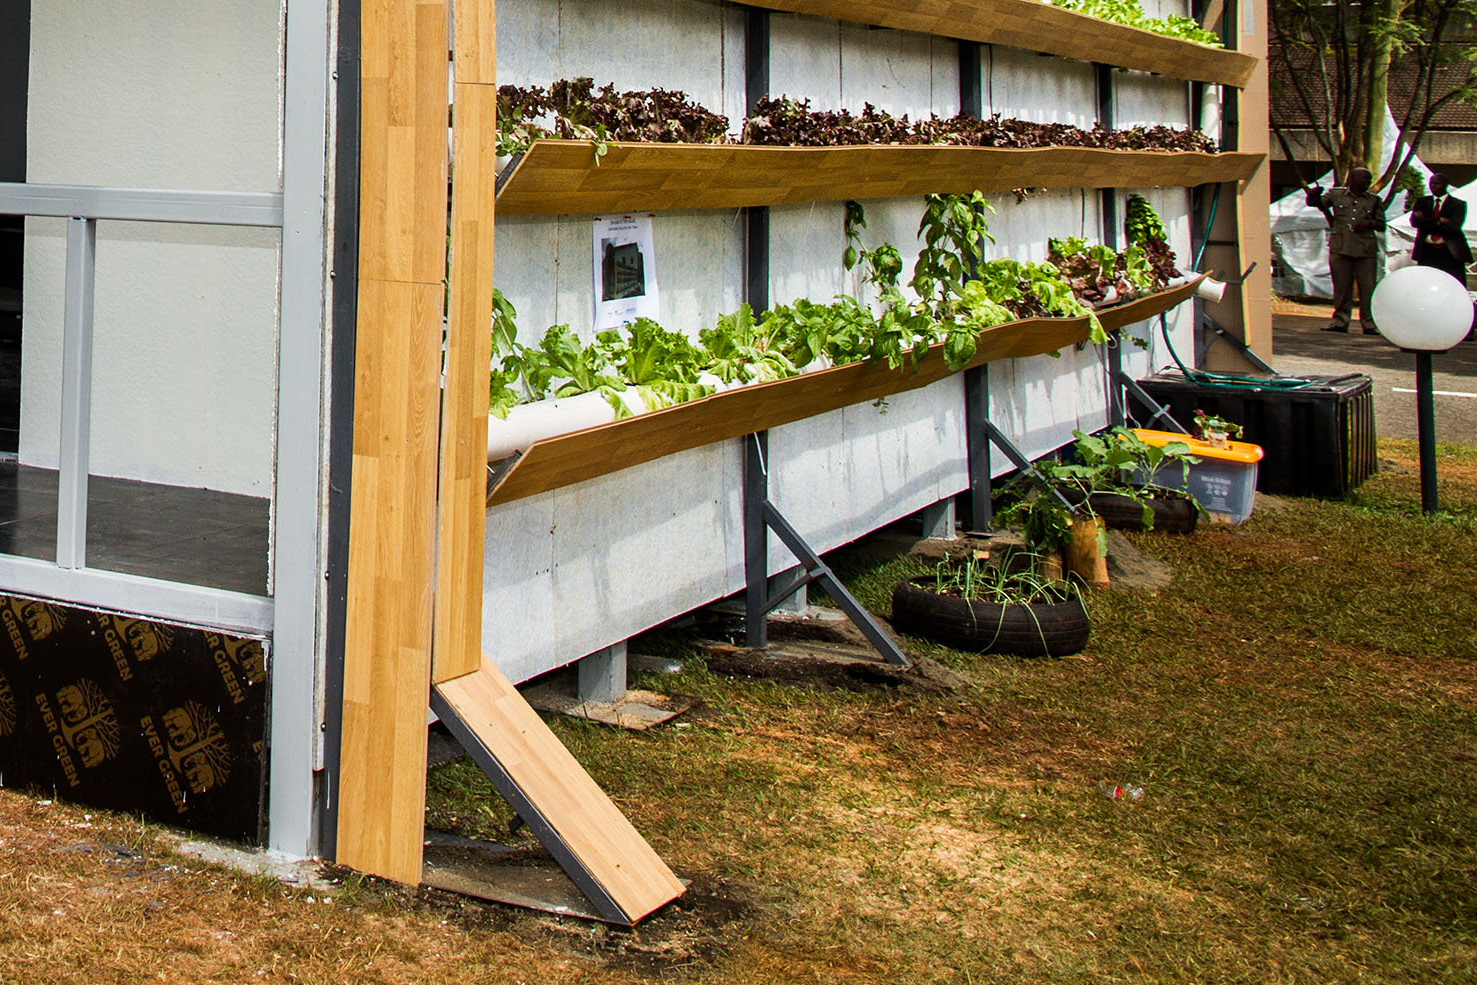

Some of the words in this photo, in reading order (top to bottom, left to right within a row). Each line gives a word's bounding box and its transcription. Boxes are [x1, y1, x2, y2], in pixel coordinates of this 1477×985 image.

[2, 608, 28, 661] GREEN
[103, 628, 133, 682] GREEN
[213, 648, 244, 704] GREEN
[36, 693, 59, 734] EVER
[52, 735, 81, 789] GREEN
[140, 716, 164, 759] EVER
[158, 760, 189, 815] GREEN
